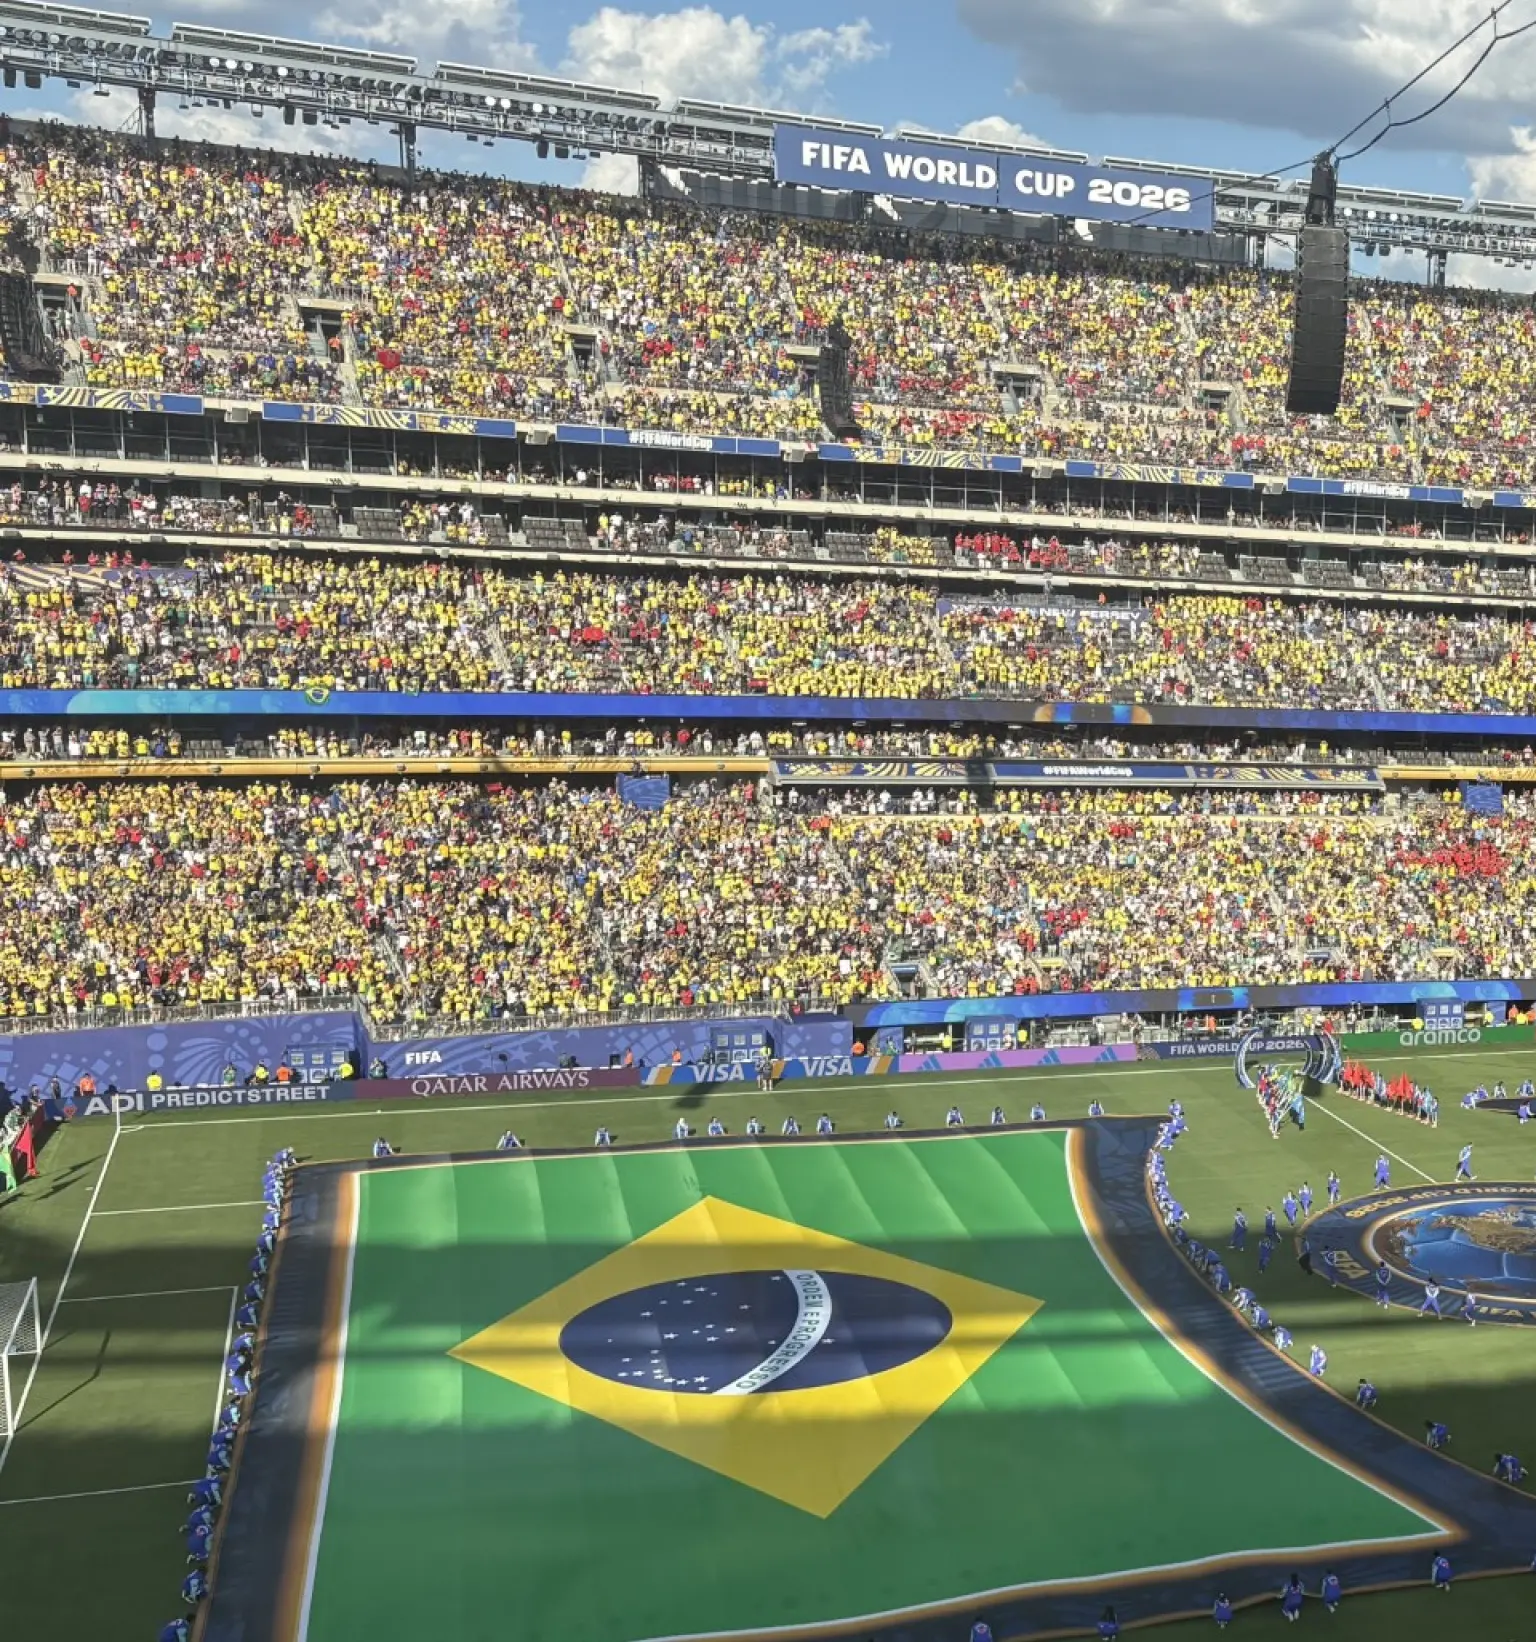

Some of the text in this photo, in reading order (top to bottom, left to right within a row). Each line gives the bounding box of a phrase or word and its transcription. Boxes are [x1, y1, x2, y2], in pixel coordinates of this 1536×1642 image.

[802, 140, 1191, 213] FIFA WORLD CUP 2026
[628, 430, 713, 451] #FIFAWorldCup
[1400, 1028, 1481, 1047] aramco
[405, 1050, 442, 1065] FIFA
[1170, 1044, 1195, 1056] FIFA
[1196, 1042, 1239, 1054] WORLD
[688, 1062, 745, 1082] VISA
[802, 1056, 854, 1077] VISA
[410, 1071, 590, 1097] QATAR AIRWAYS
[84, 1085, 331, 1116] ADI PREDICTSTREET
[735, 1318, 820, 1389] PROGRESSO
